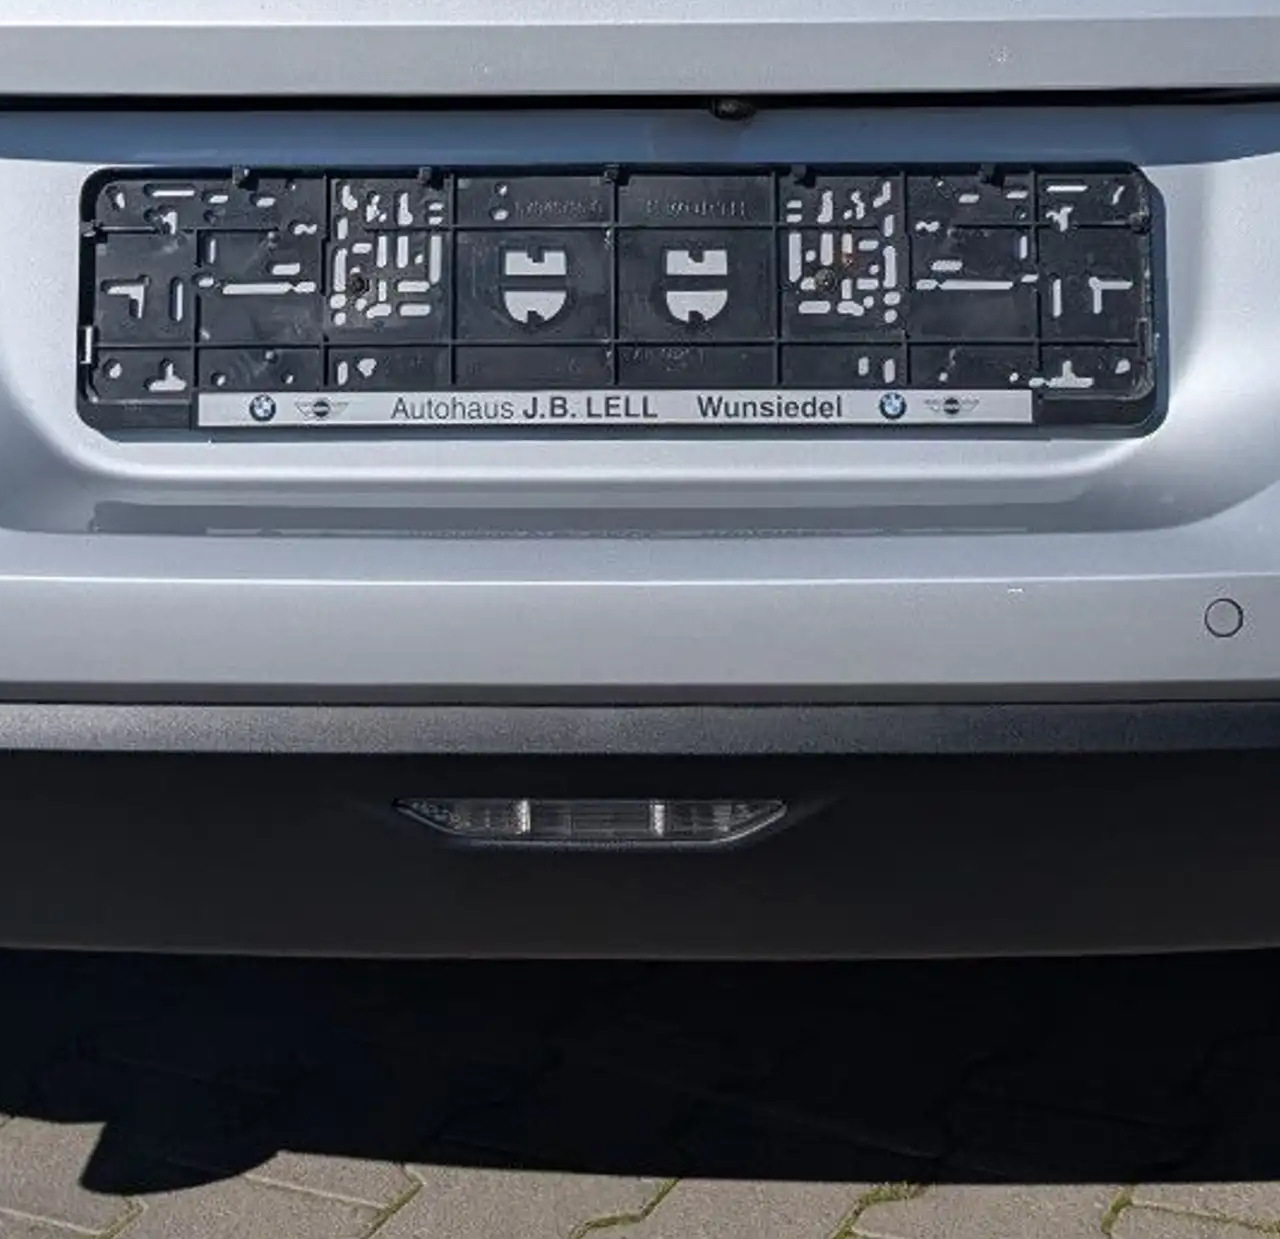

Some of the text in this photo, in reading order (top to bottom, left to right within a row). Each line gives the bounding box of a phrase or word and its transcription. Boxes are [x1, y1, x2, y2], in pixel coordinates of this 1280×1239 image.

[390, 394, 844, 420] Autohaus J.B. LELL Wunsiedel
